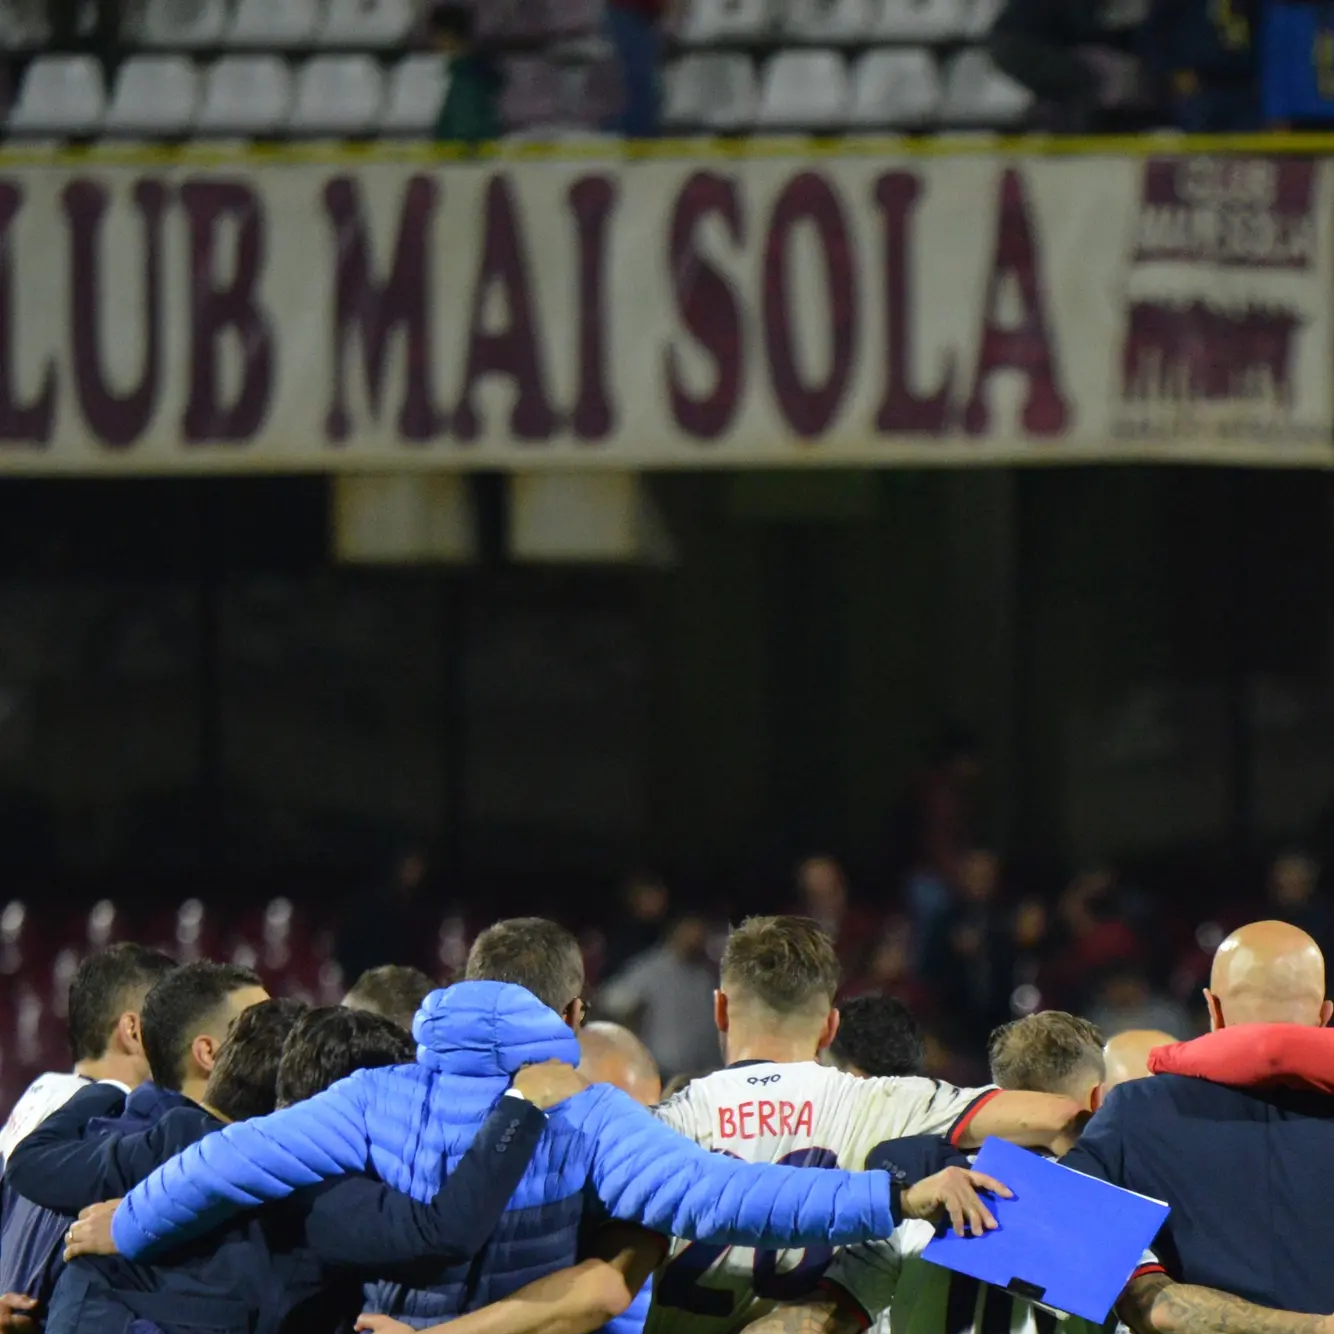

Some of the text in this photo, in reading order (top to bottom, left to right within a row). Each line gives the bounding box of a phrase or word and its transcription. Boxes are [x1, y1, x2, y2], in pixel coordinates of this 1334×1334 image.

[323, 173, 620, 443] MAI
[665, 169, 1075, 442] SOLA
[719, 1100, 813, 1139] BERRA
